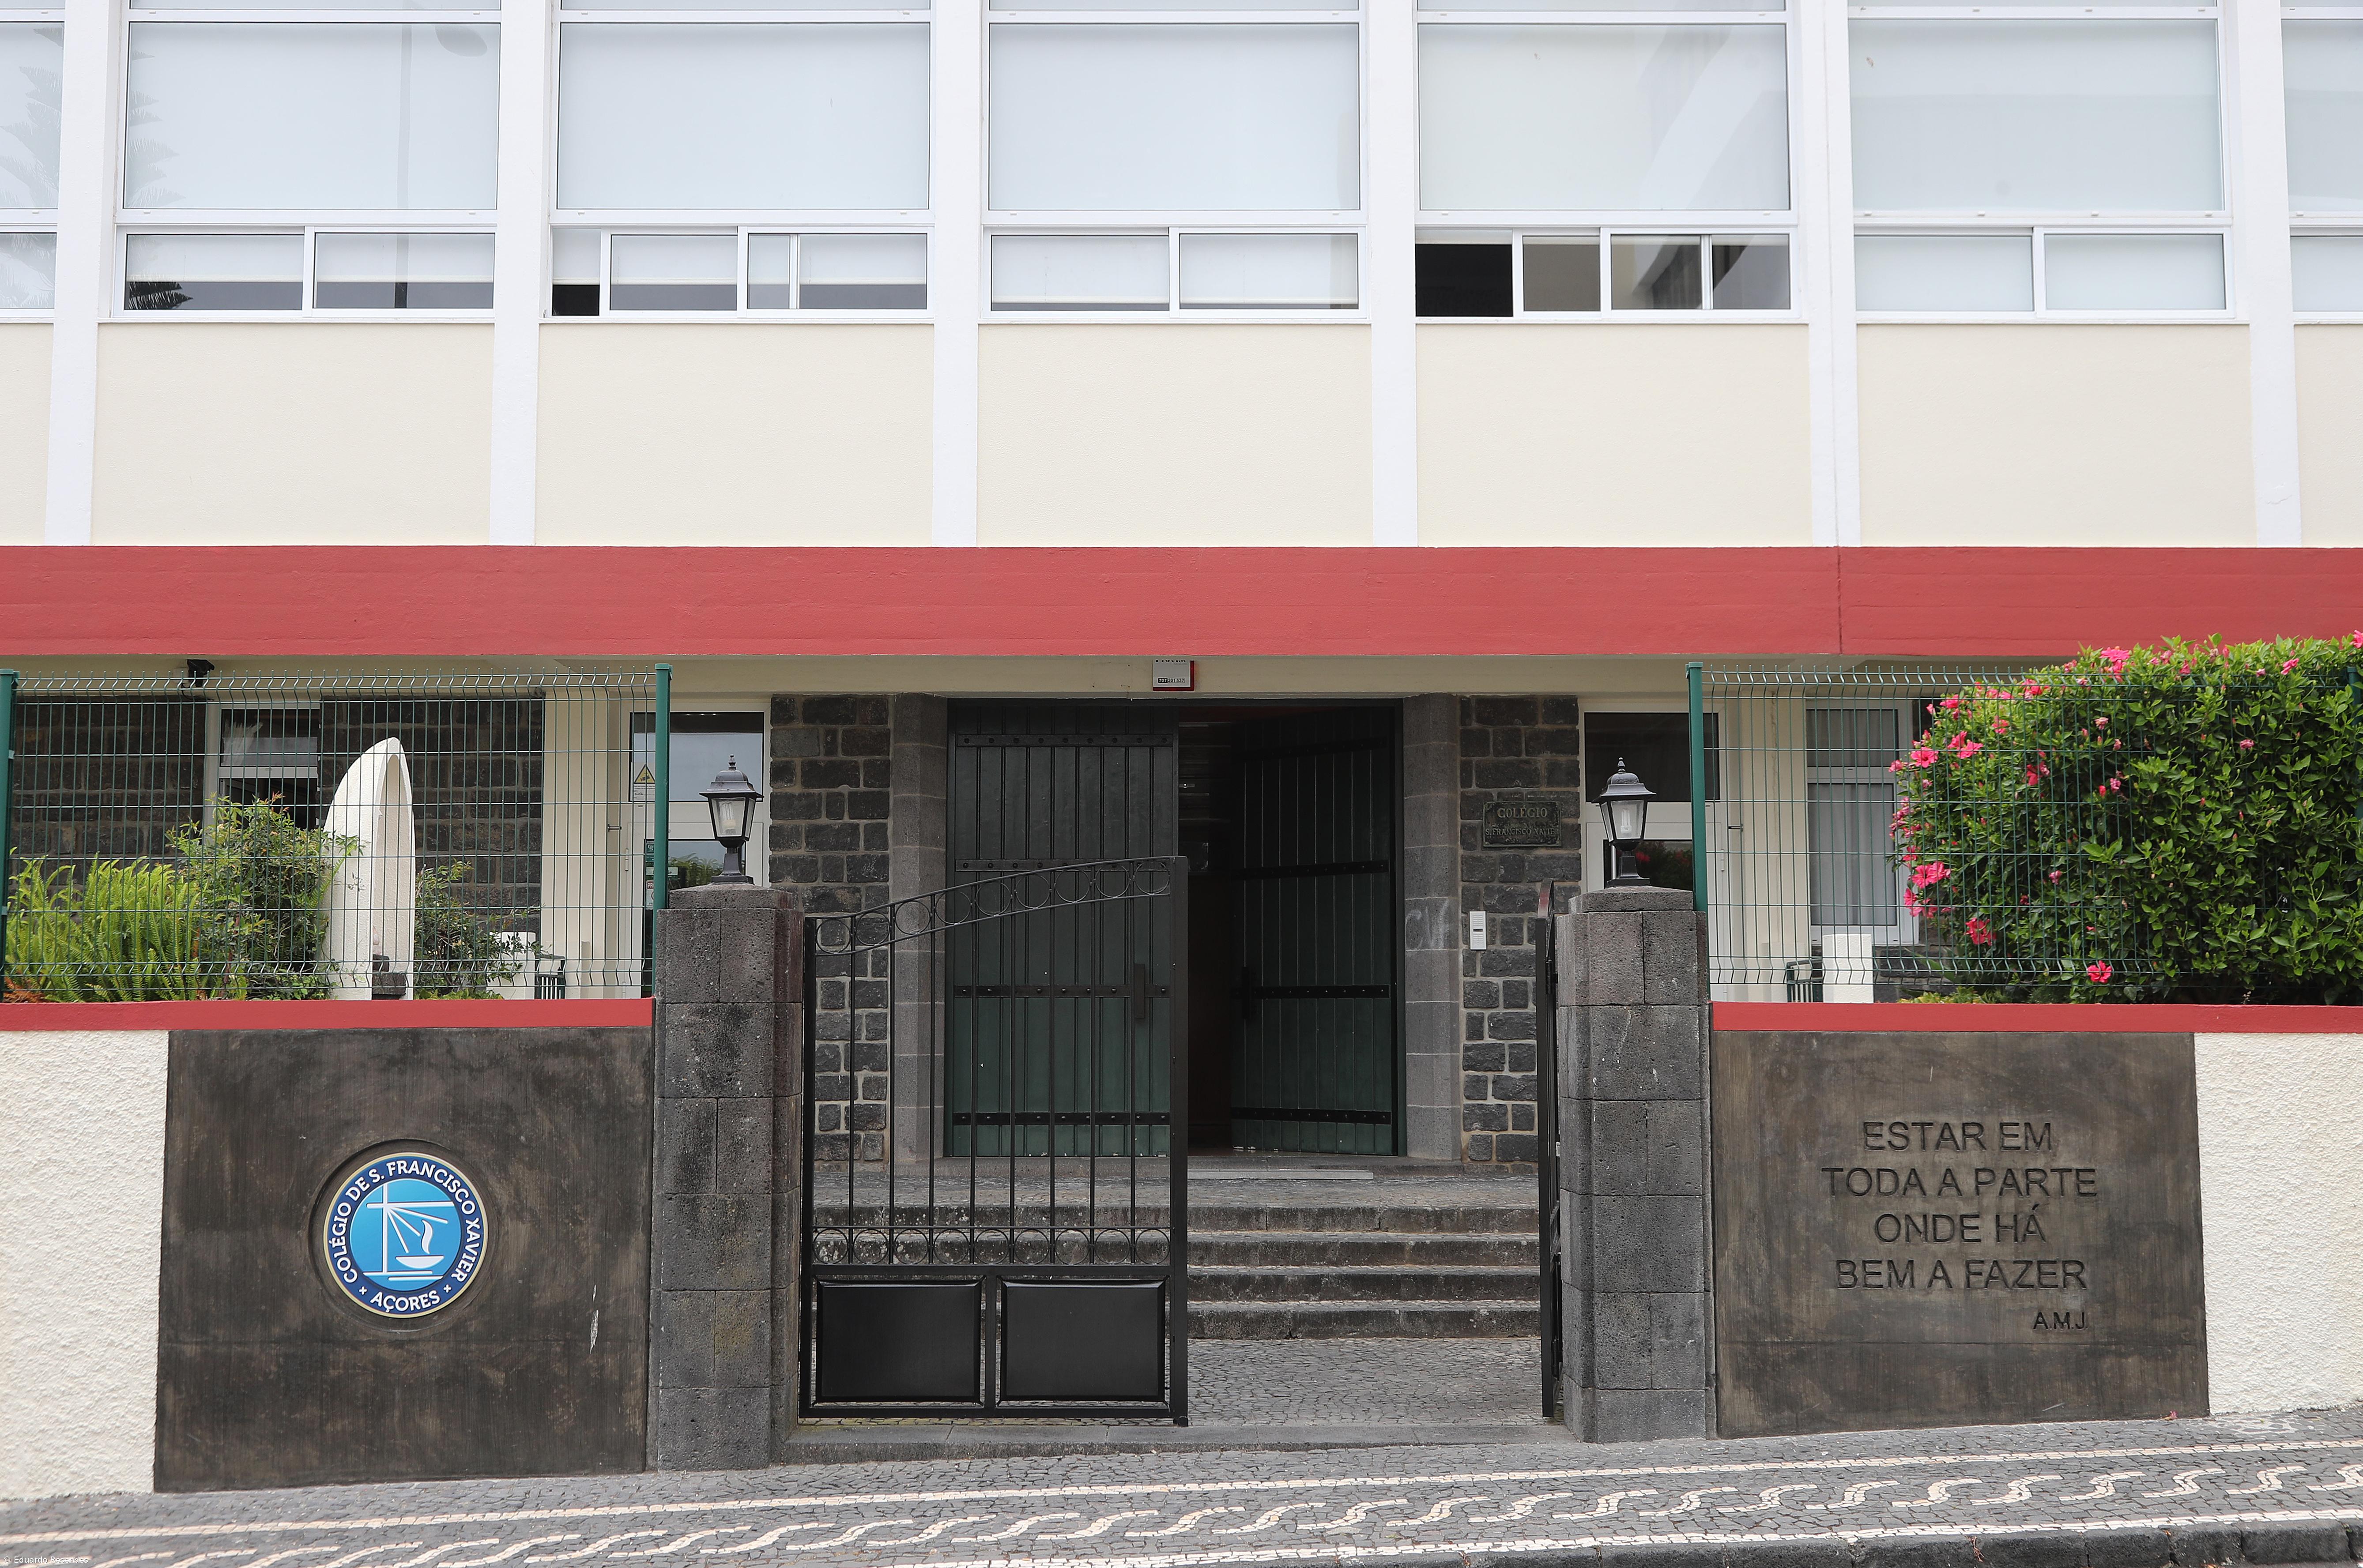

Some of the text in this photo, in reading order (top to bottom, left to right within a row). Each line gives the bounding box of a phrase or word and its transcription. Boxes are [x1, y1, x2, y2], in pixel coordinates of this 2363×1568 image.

[1497, 805, 1547, 818] COLÉGIO
[1863, 1121, 2052, 1151] ESTAR EM
[1821, 1167, 2097, 1197] TODA A PARTE
[328, 1160, 481, 1283] COLÉGIO DE S. FRANCISCO XAVIER
[1875, 1203, 2046, 1243] ONDE HÁ
[1836, 1260, 2087, 1290] BEM A FAZER
[370, 1290, 441, 1313] AÇORES
